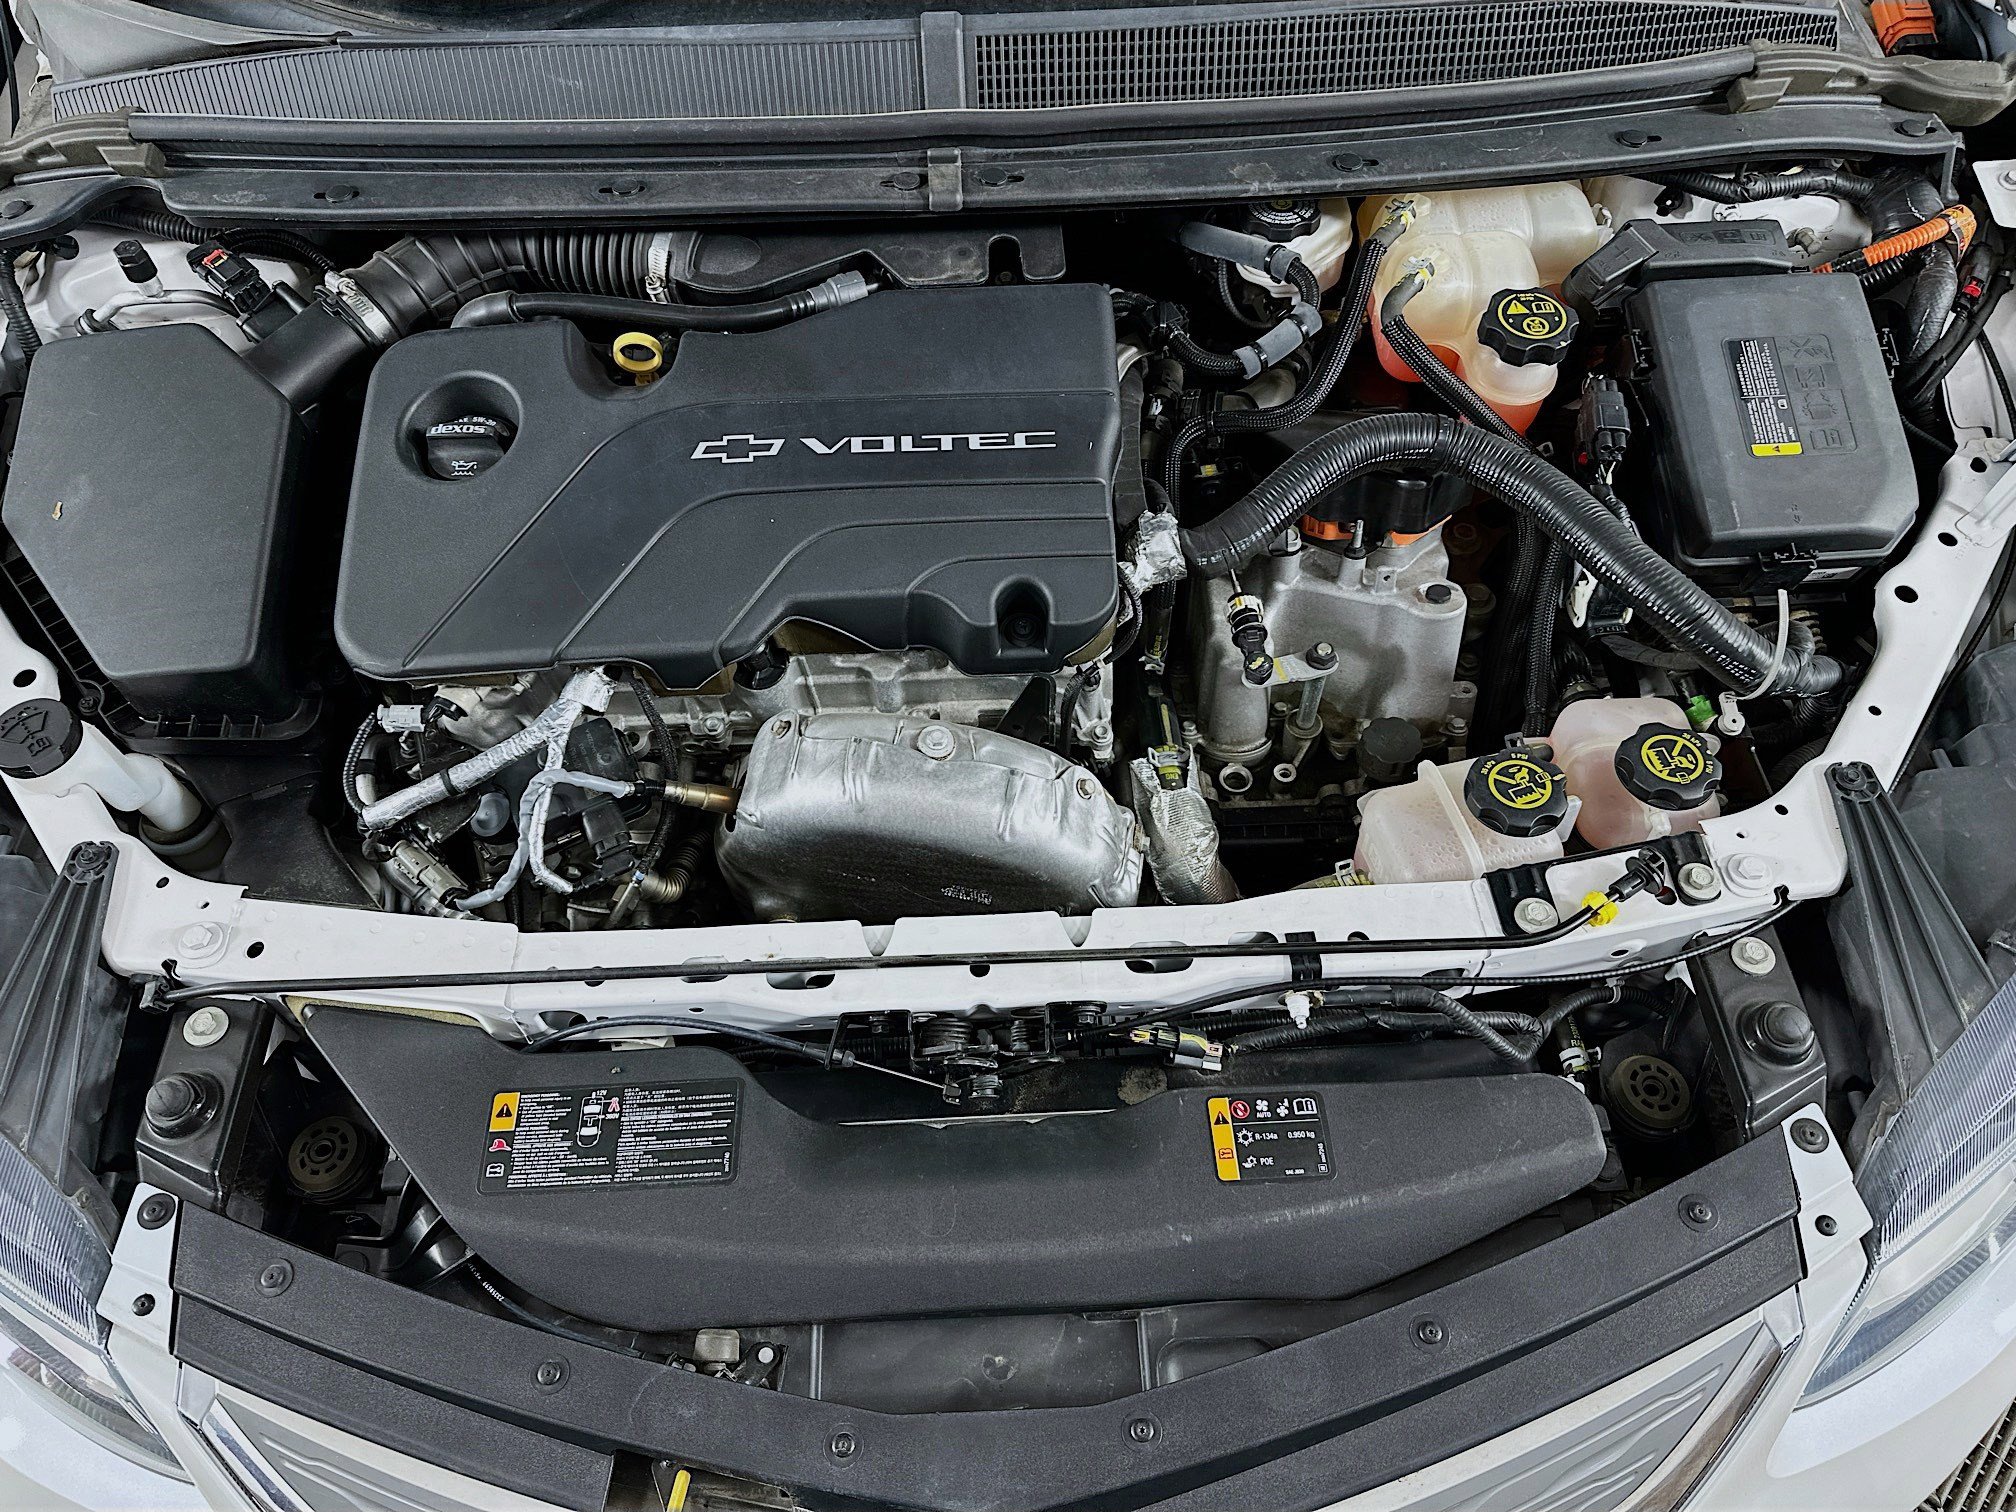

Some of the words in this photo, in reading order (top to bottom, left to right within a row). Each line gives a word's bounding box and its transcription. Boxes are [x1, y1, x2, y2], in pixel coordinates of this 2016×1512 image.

[430, 424, 486, 434] dexos
[800, 431, 1056, 454] VOLTEC
[1255, 1131, 1278, 1140] R-134a
[1287, 1130, 1305, 1139] 0.950
[1306, 1130, 1315, 1139] kg
[1260, 1157, 1274, 1165] POE
